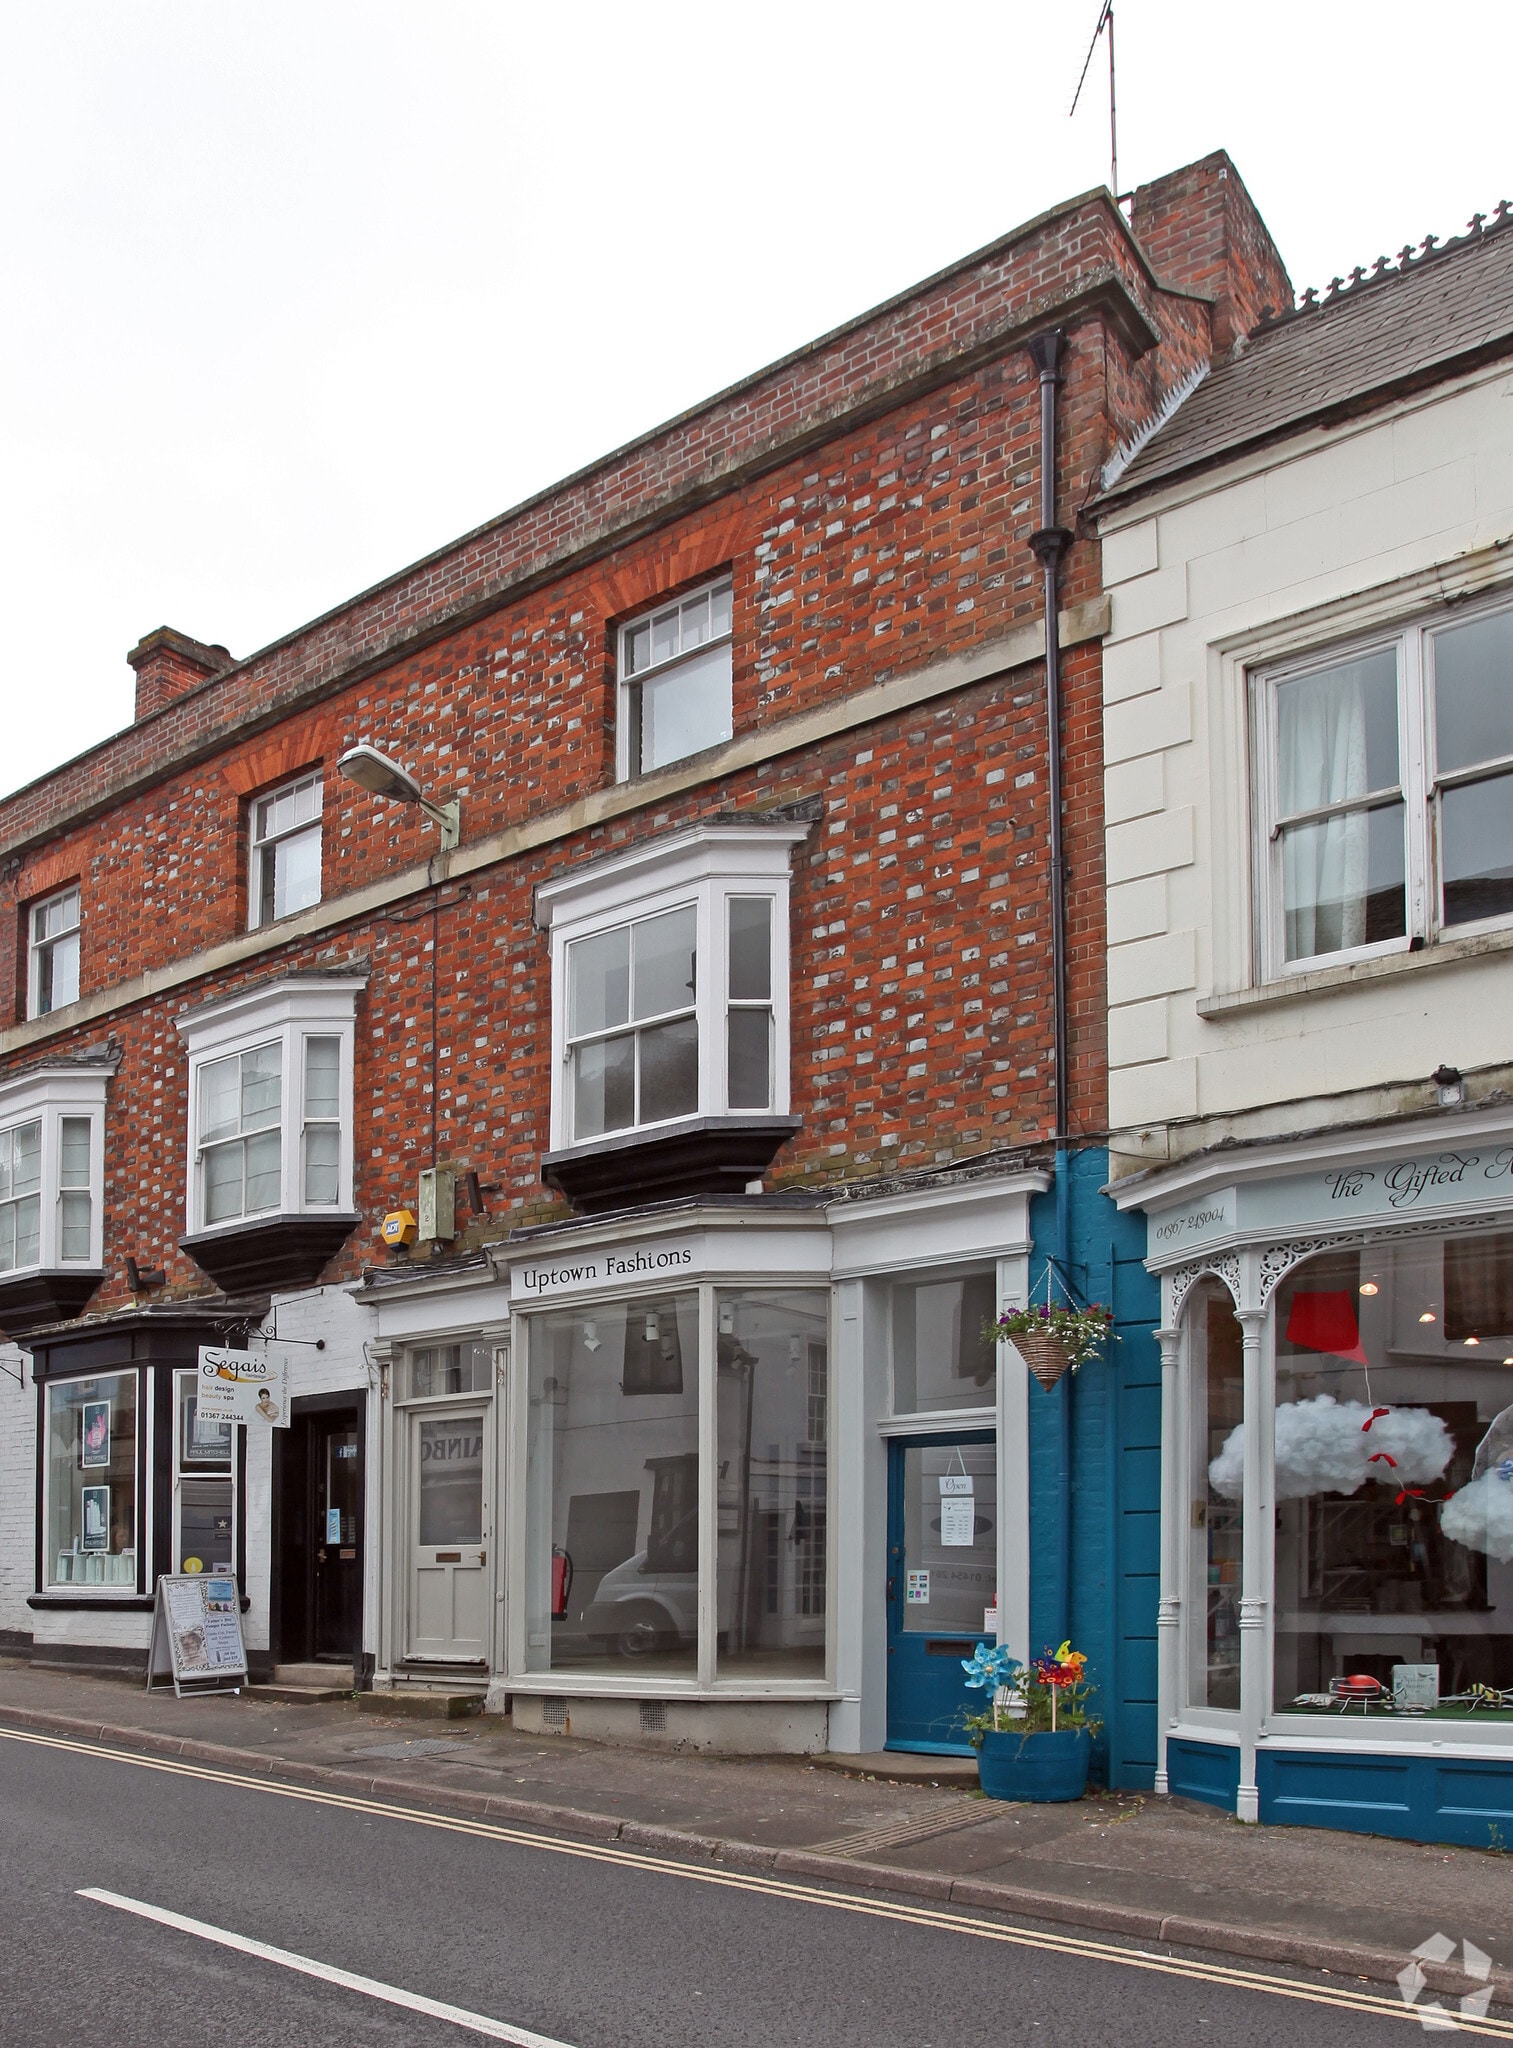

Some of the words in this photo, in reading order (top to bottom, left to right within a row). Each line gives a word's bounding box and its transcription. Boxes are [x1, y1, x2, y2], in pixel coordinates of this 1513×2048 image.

[1325, 1170, 1375, 1199] the
[1384, 1153, 1480, 1208] Gifted
[386, 1221, 400, 1234] ADT
[1156, 1217, 1186, 1240] 01367
[1187, 1206, 1225, 1230] 248004
[523, 1265, 597, 1294] Uptown
[605, 1249, 692, 1276] Fashions
[202, 1351, 267, 1382] Segais
[201, 1392, 222, 1400] beauty
[214, 1385, 235, 1393] design
[221, 1413, 244, 1421] 244344
[944, 1478, 967, 1494] Open
